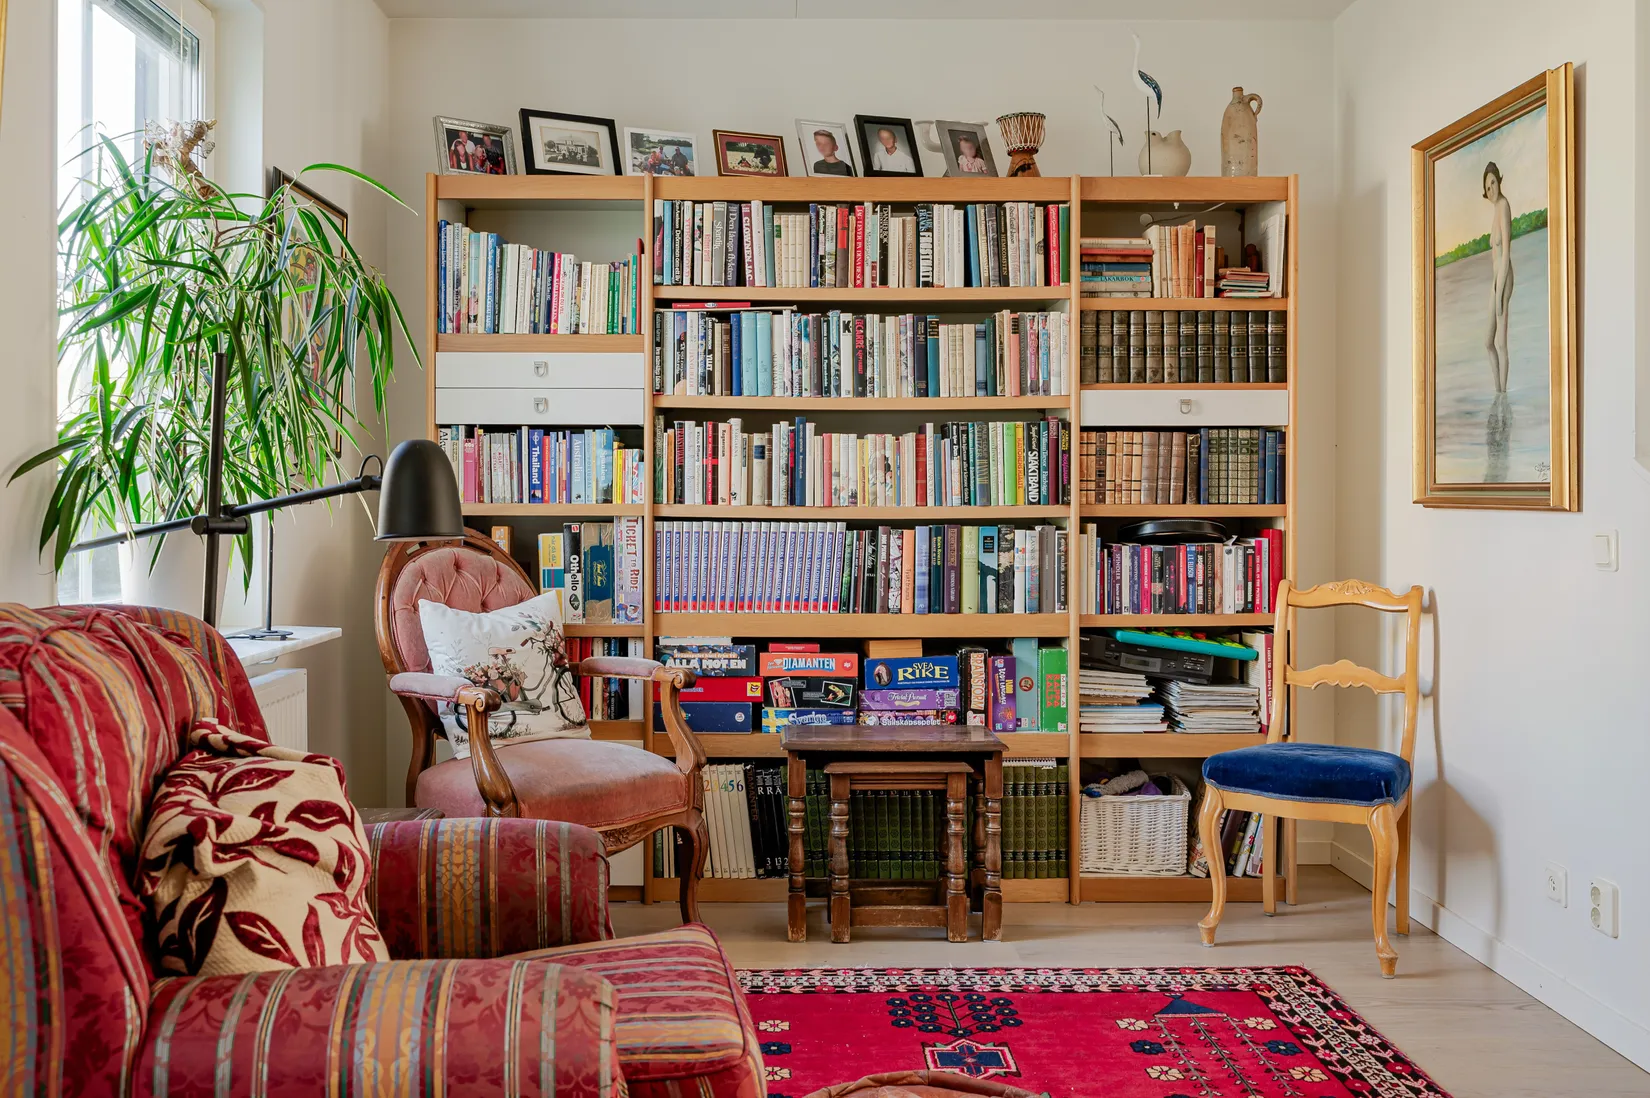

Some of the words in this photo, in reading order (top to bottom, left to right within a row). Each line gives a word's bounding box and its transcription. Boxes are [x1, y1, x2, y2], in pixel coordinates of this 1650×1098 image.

[728, 213, 737, 230] Den
[714, 220, 723, 250] Shardik
[727, 231, 737, 252] långa
[743, 217, 752, 264] CLOWNEN
[727, 253, 736, 281] flykten
[677, 428, 685, 466] TRANSYLVANIA
[532, 446, 540, 484] Thailand
[573, 439, 582, 482] Australien
[600, 450, 608, 481] Spanien
[977, 460, 989, 484] HANNAH
[1028, 451, 1040, 502] SLÄKTBAND
[626, 517, 639, 556] TICKET
[630, 559, 637, 568] TO
[570, 555, 579, 592] Othello
[630, 570, 640, 592] RIDE
[666, 659, 700, 669] ALLA
[702, 659, 728, 670] MOT
[729, 660, 747, 670] EN
[782, 657, 835, 671] DIAMANTEN
[913, 662, 935, 671] SVEA
[898, 666, 950, 681] RIKE
[971, 654, 984, 709] BRAINSTORM
[888, 692, 907, 702] Trivial
[907, 692, 928, 703] Pursuit
[788, 711, 828, 726] Sverige
[882, 718, 941, 726] Sällskapsspelet
[704, 780, 711, 792] 2
[720, 780, 729, 792] 4
[728, 780, 735, 792] 5
[736, 780, 744, 792] 6
[758, 786, 765, 795] R
[766, 786, 774, 795] R
[746, 768, 759, 821] DIAMANTER
[766, 858, 772, 866] 3
[775, 858, 782, 867] 13
